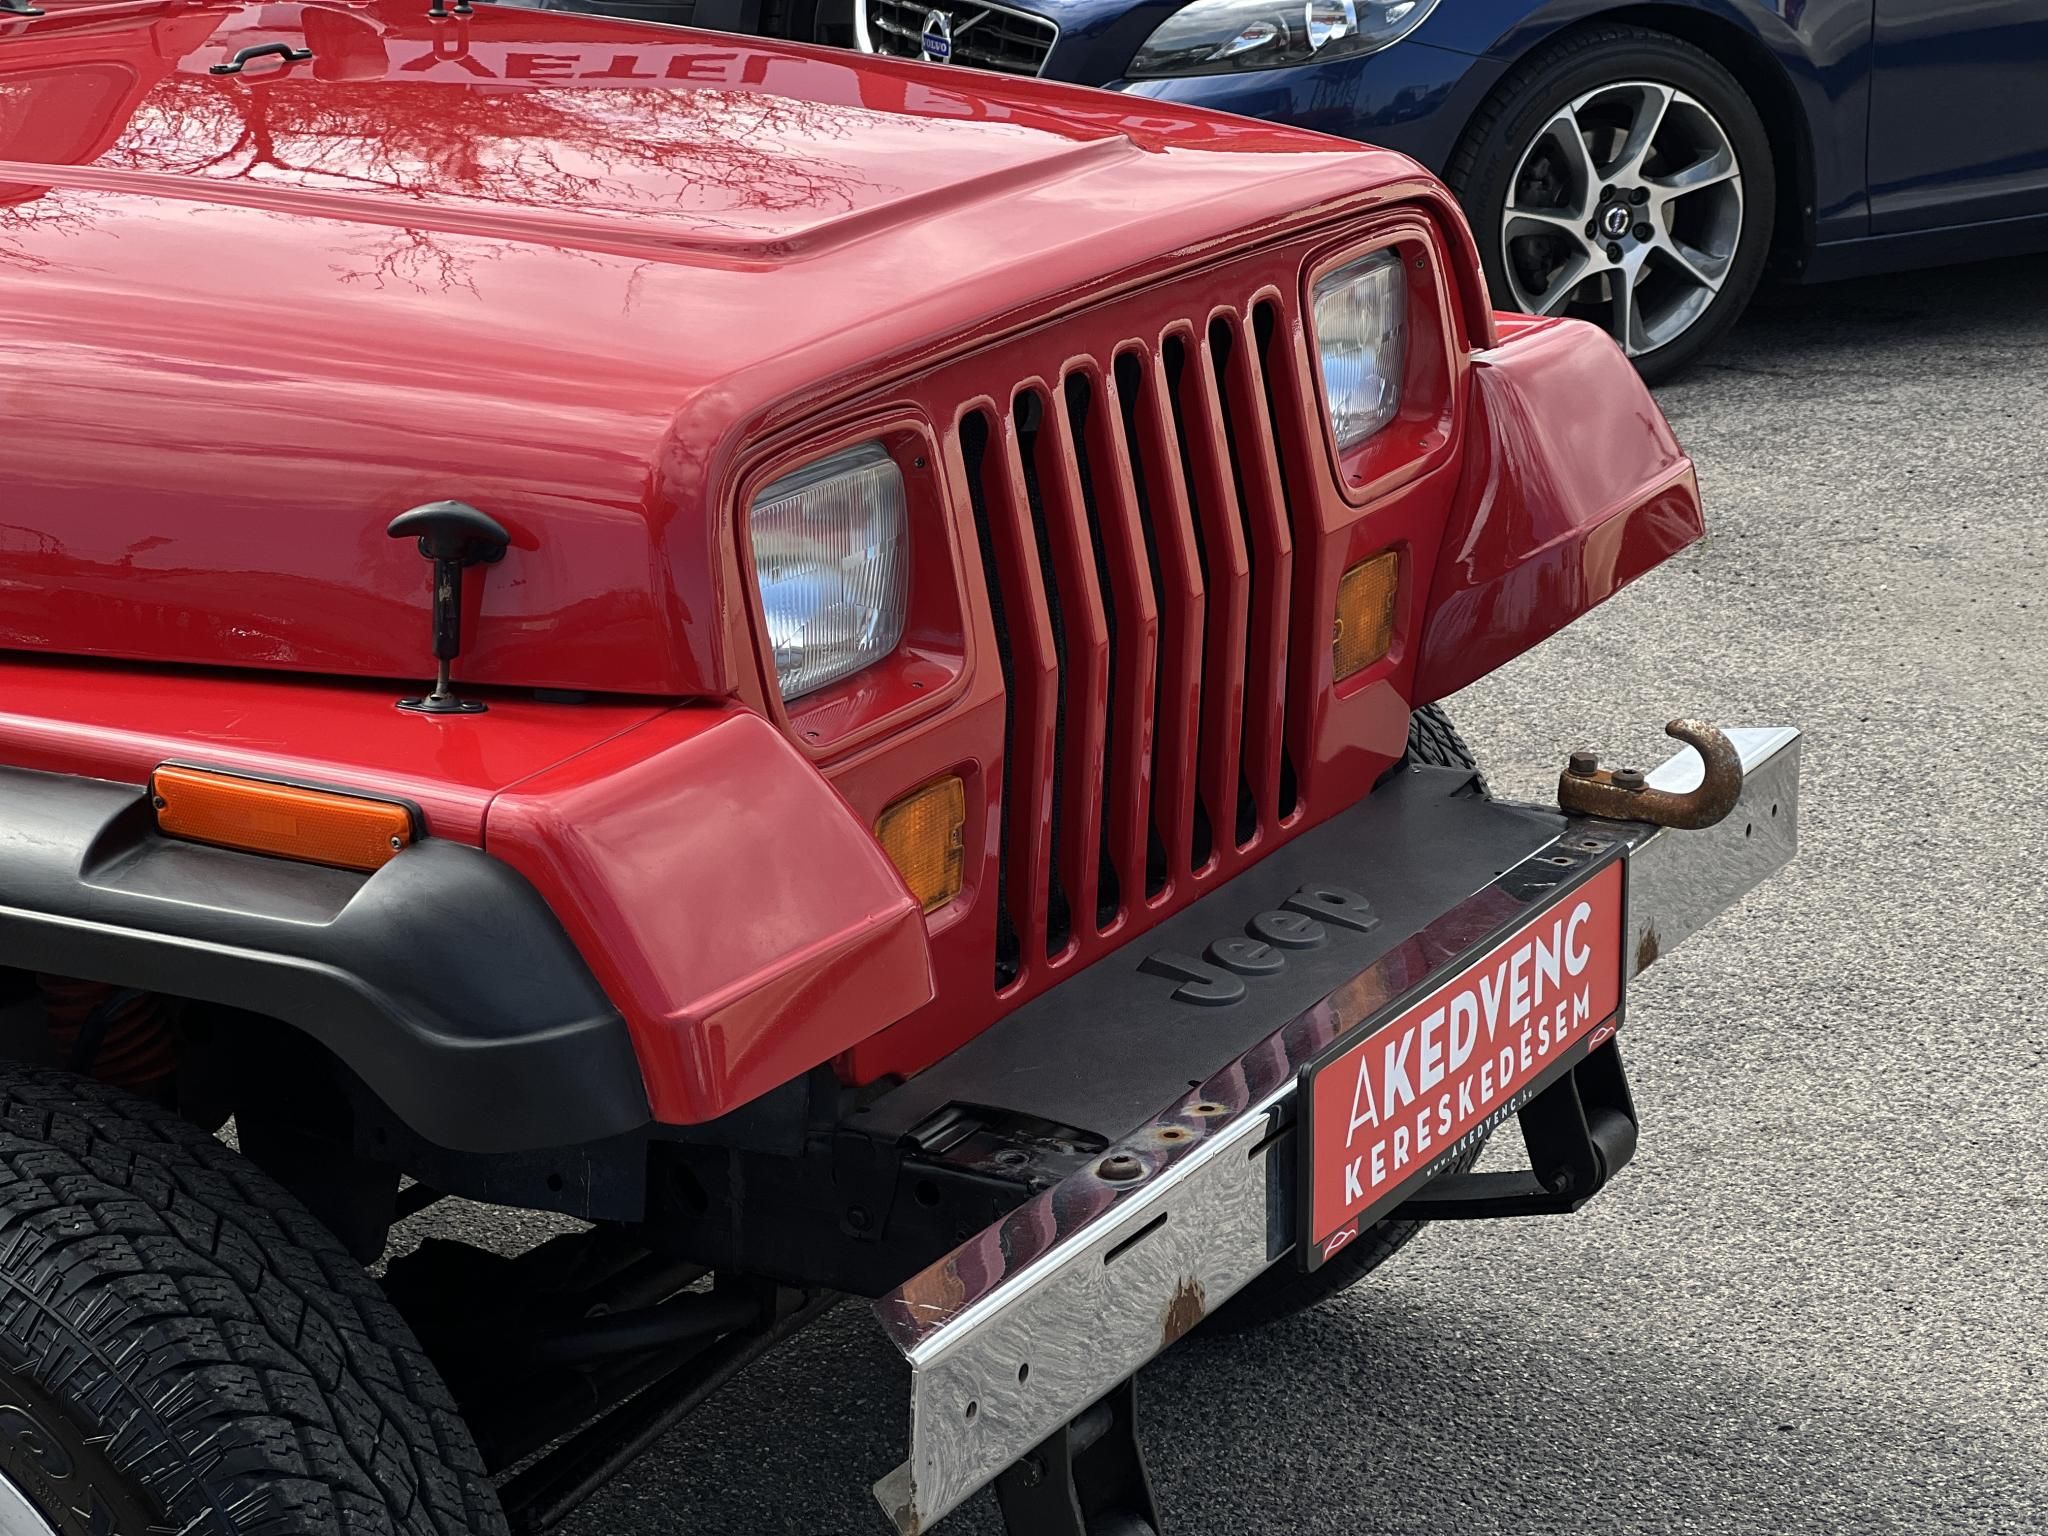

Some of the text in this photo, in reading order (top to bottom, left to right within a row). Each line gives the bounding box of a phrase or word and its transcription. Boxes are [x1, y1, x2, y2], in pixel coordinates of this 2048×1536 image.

[1137, 883, 1380, 1007] Jeep
[1344, 983, 1591, 1206] KERESKEDÉSEM
[1426, 1089, 1533, 1177] www.AKEDVENC.hu
